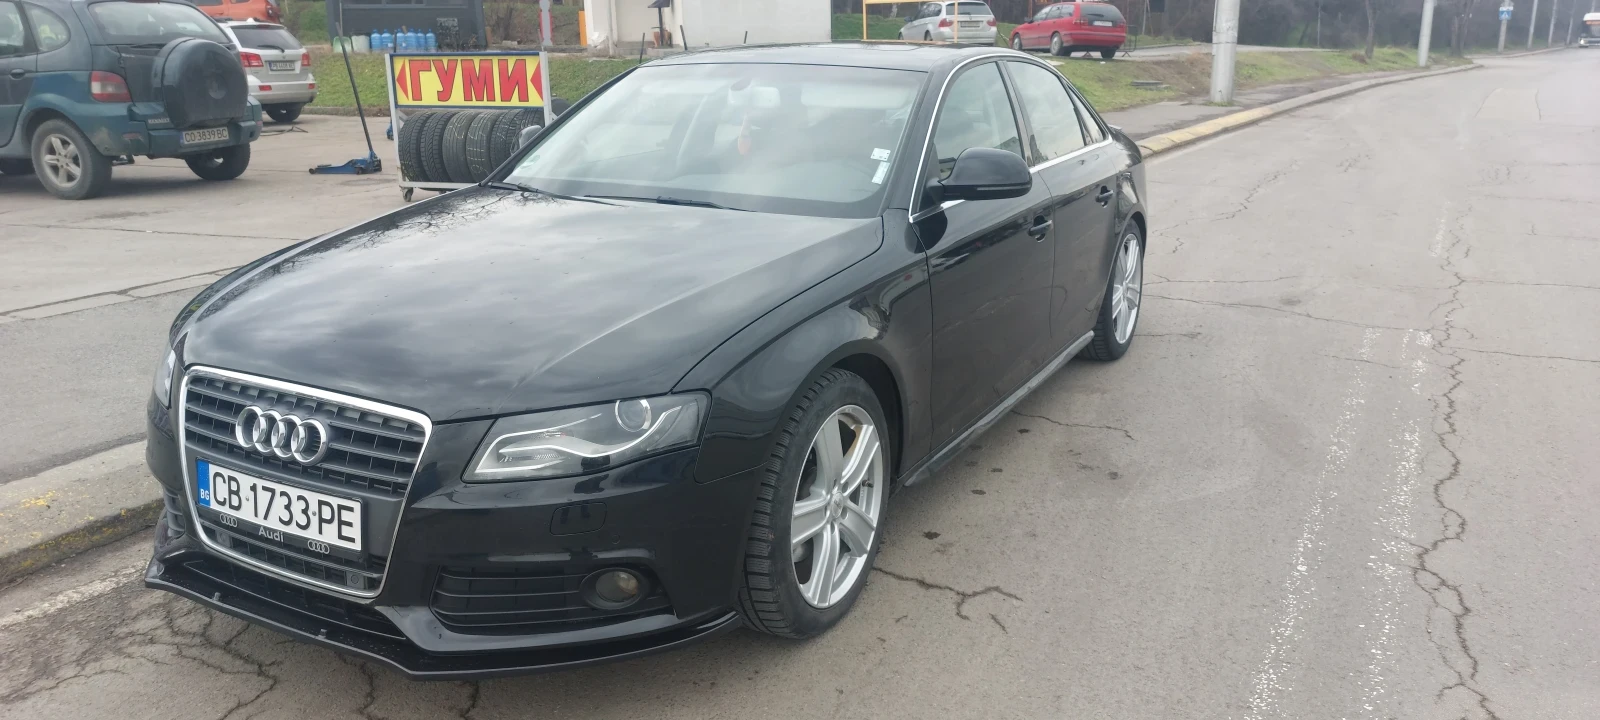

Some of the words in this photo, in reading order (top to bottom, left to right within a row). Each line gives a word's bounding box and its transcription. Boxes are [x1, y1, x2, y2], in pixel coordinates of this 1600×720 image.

[408, 59, 530, 102] ГУМИ
[197, 129, 216, 141] 3839
[216, 128, 228, 139] BC
[200, 488, 210, 500] BG
[212, 471, 242, 512] CB
[250, 483, 311, 531] 1733
[317, 499, 356, 544] PE
[258, 526, 284, 542] Audi
